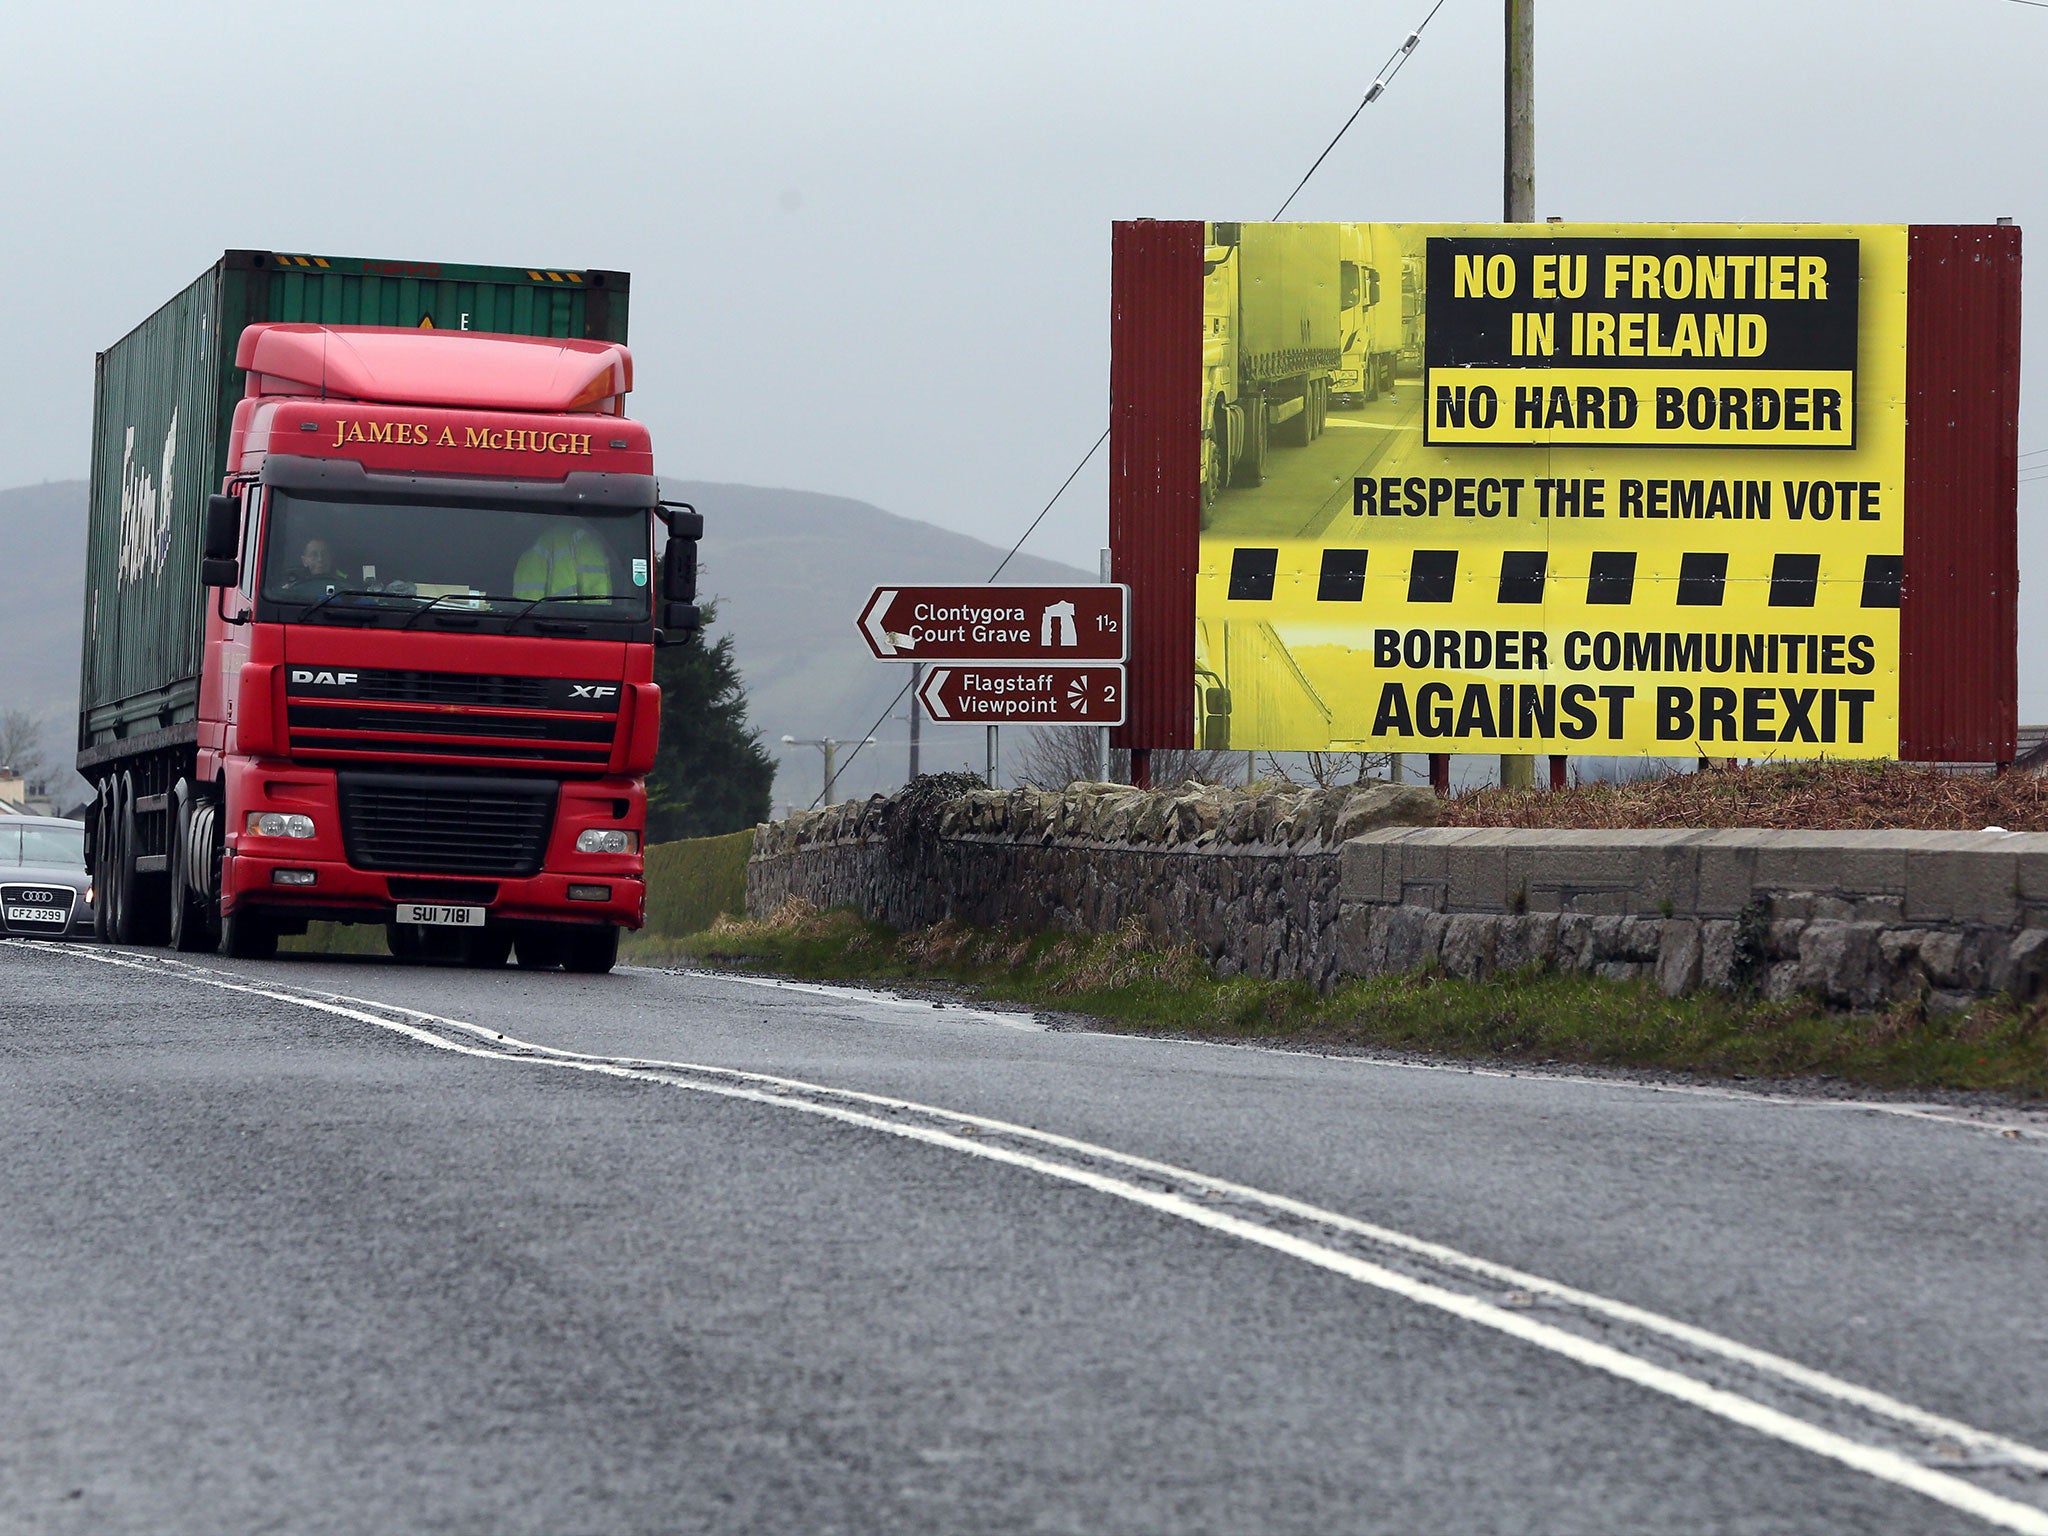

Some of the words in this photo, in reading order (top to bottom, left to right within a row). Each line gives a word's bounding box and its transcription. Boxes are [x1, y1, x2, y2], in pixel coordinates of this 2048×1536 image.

[1453, 254, 1516, 299] NO
[1533, 254, 1588, 299] EU
[1604, 255, 1829, 300] FRONTIER
[1511, 312, 1555, 356] IN
[1571, 312, 1768, 357] IRELAND
[1436, 385, 1498, 429] NO
[1514, 386, 1639, 430] HARD
[1655, 387, 1842, 431] BORDER
[332, 420, 430, 449] JAMES
[436, 425, 457, 447] A
[464, 427, 593, 455] McHUGH
[1353, 477, 1525, 517] RESPECT
[1534, 478, 1606, 518] THE
[1618, 480, 1772, 520] REMAIN
[1783, 481, 1882, 521] VOTE
[914, 603, 1025, 625] Clontygora
[909, 625, 966, 643] Court
[972, 625, 1031, 643] Grave
[1374, 629, 1548, 670] BORDER
[1564, 631, 1875, 675] COMMUNITIES
[291, 670, 358, 685] DAF
[568, 684, 617, 699] XF
[963, 674, 1053, 694] Flagstaff
[1104, 686, 1116, 703] 2
[958, 696, 1057, 716] Viewpoint
[1371, 682, 1635, 740] AGAINST
[1656, 686, 1875, 744] BREXIT
[12, 909, 32, 919] CFZ
[35, 910, 61, 921] 3299
[441, 908, 470, 923] 7181
